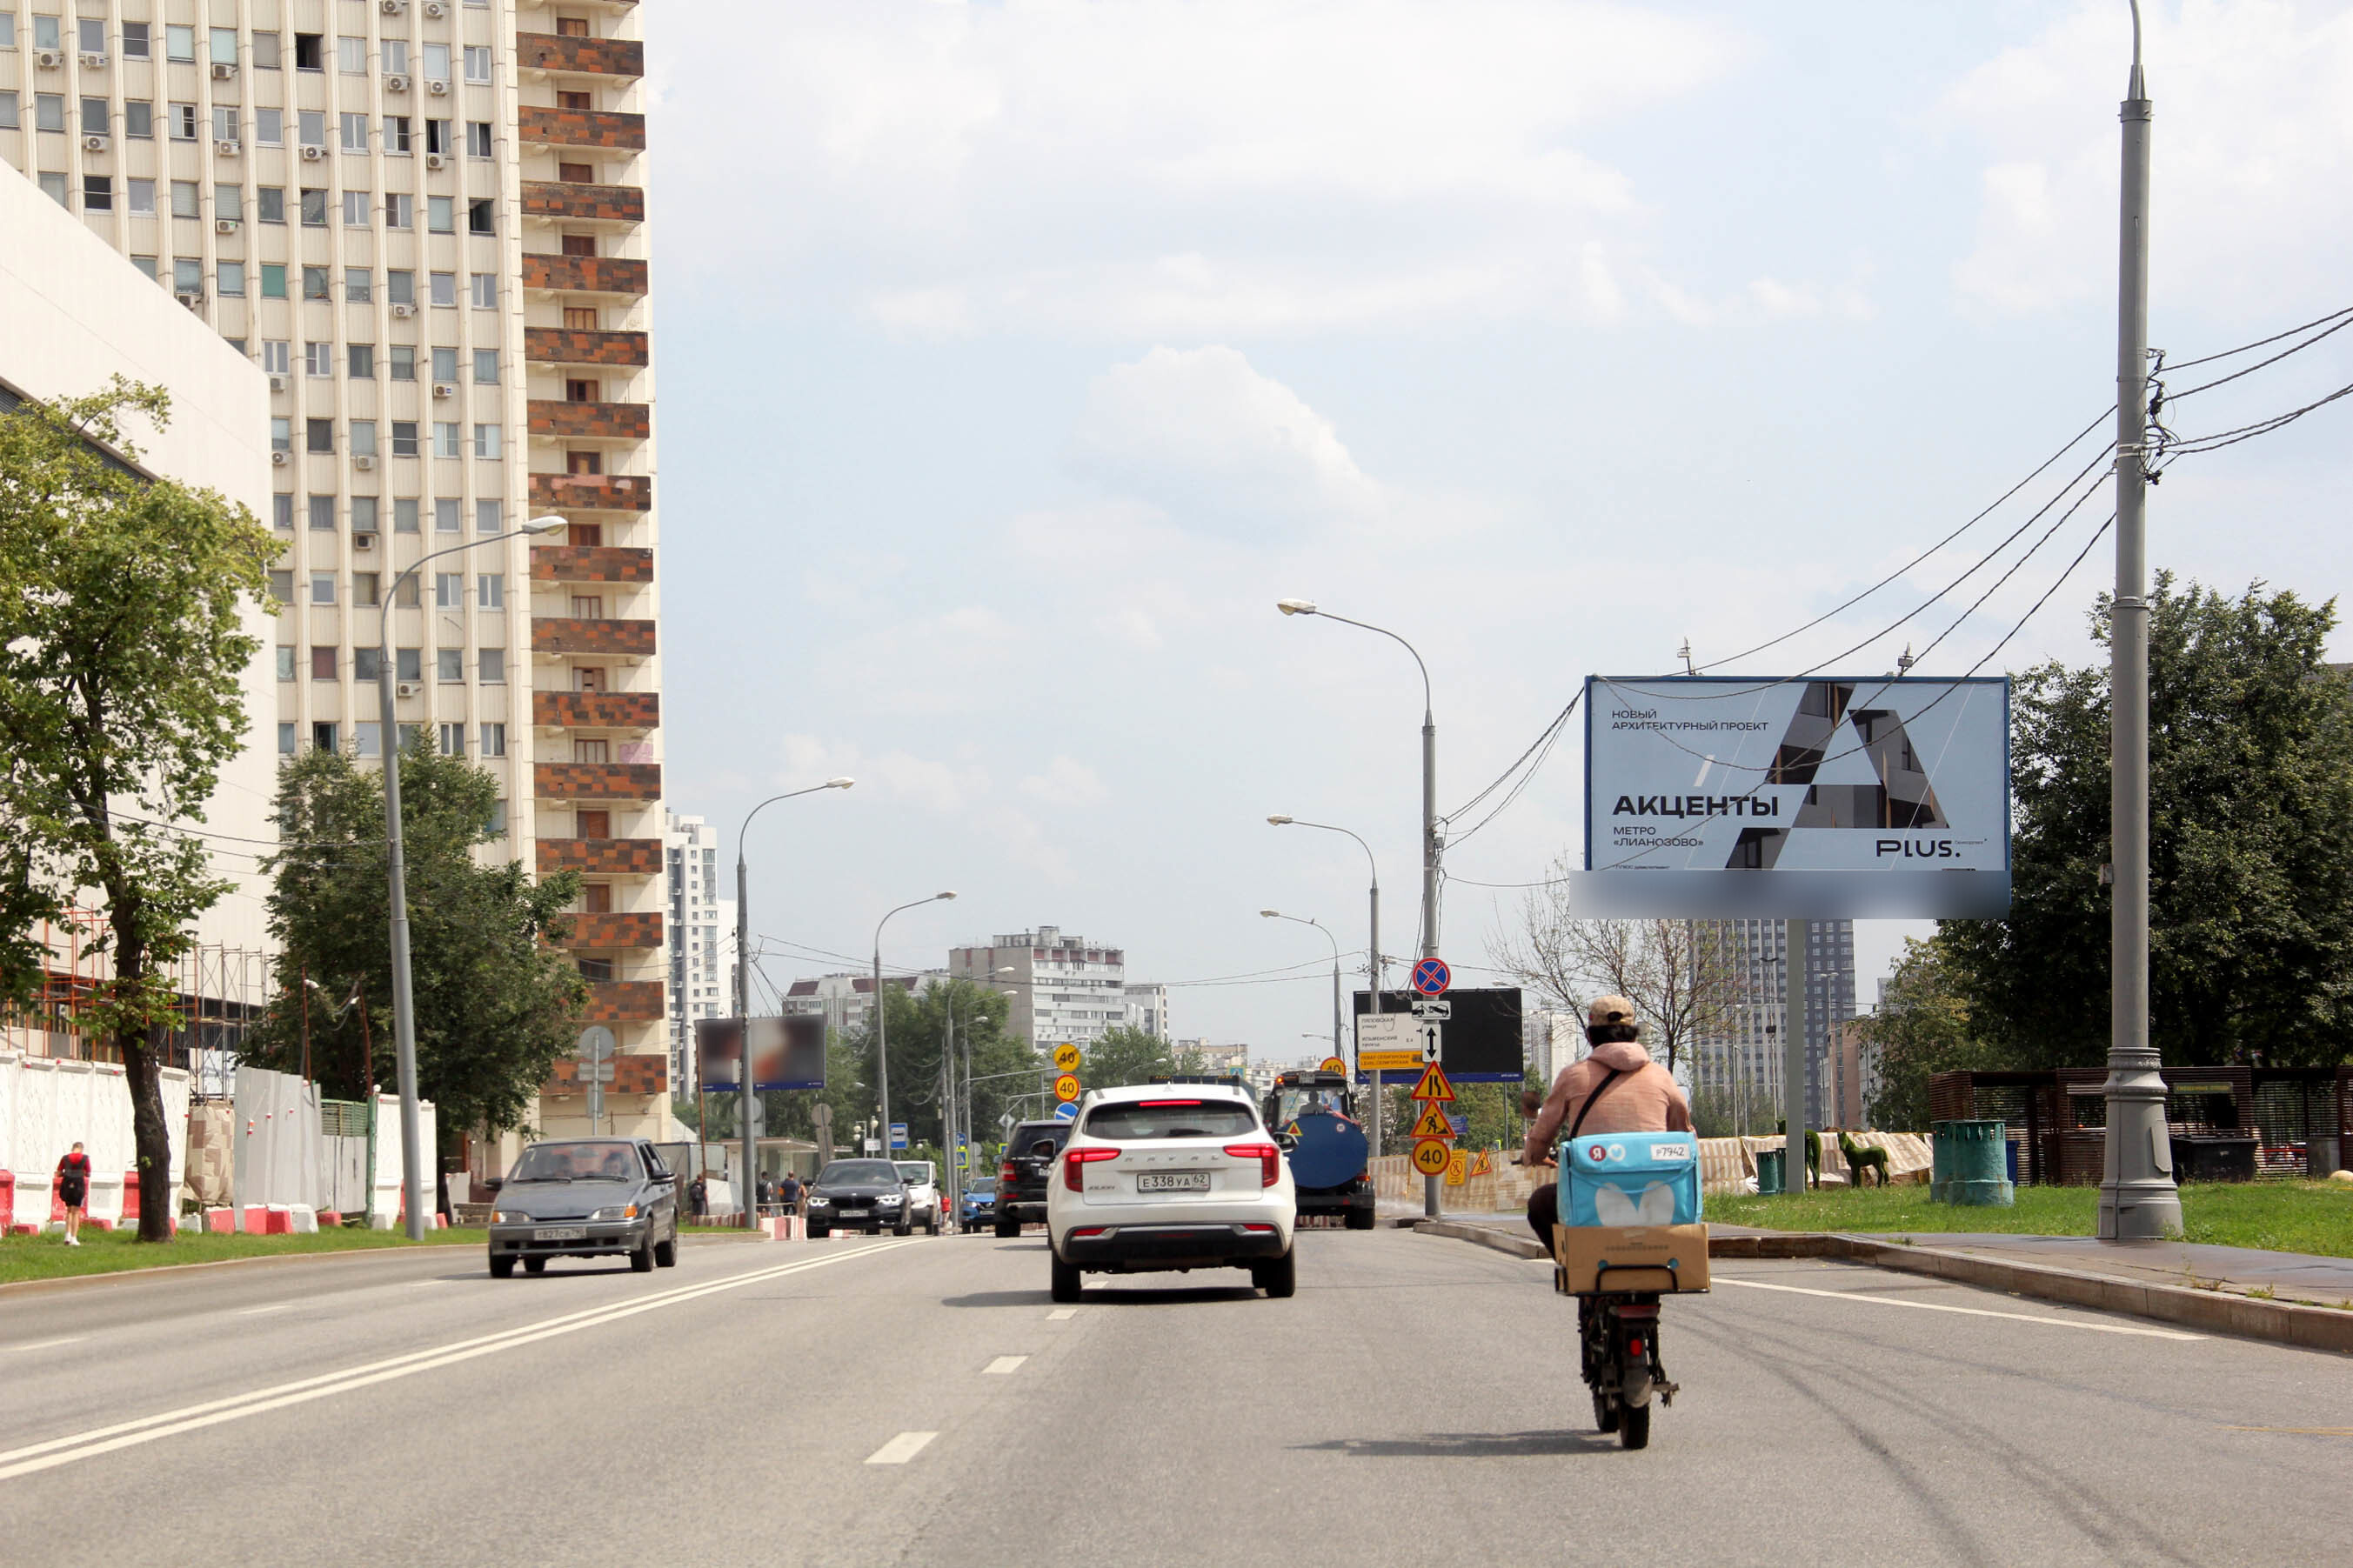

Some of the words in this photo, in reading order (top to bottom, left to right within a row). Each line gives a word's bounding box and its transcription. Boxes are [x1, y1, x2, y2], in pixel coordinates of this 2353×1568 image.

[1612, 710, 1657, 719] НОВЫЙ
[1612, 721, 1717, 731] АРХИТЕКТУРНЫЙ
[1613, 796, 1778, 819] АКЦЕНТЫ
[1060, 1052, 1075, 1064] 40
[1060, 1083, 1074, 1093] 40
[1420, 1150, 1442, 1164] 40
[1593, 1147, 1602, 1159] Я
[1193, 1175, 1205, 1184] 62
